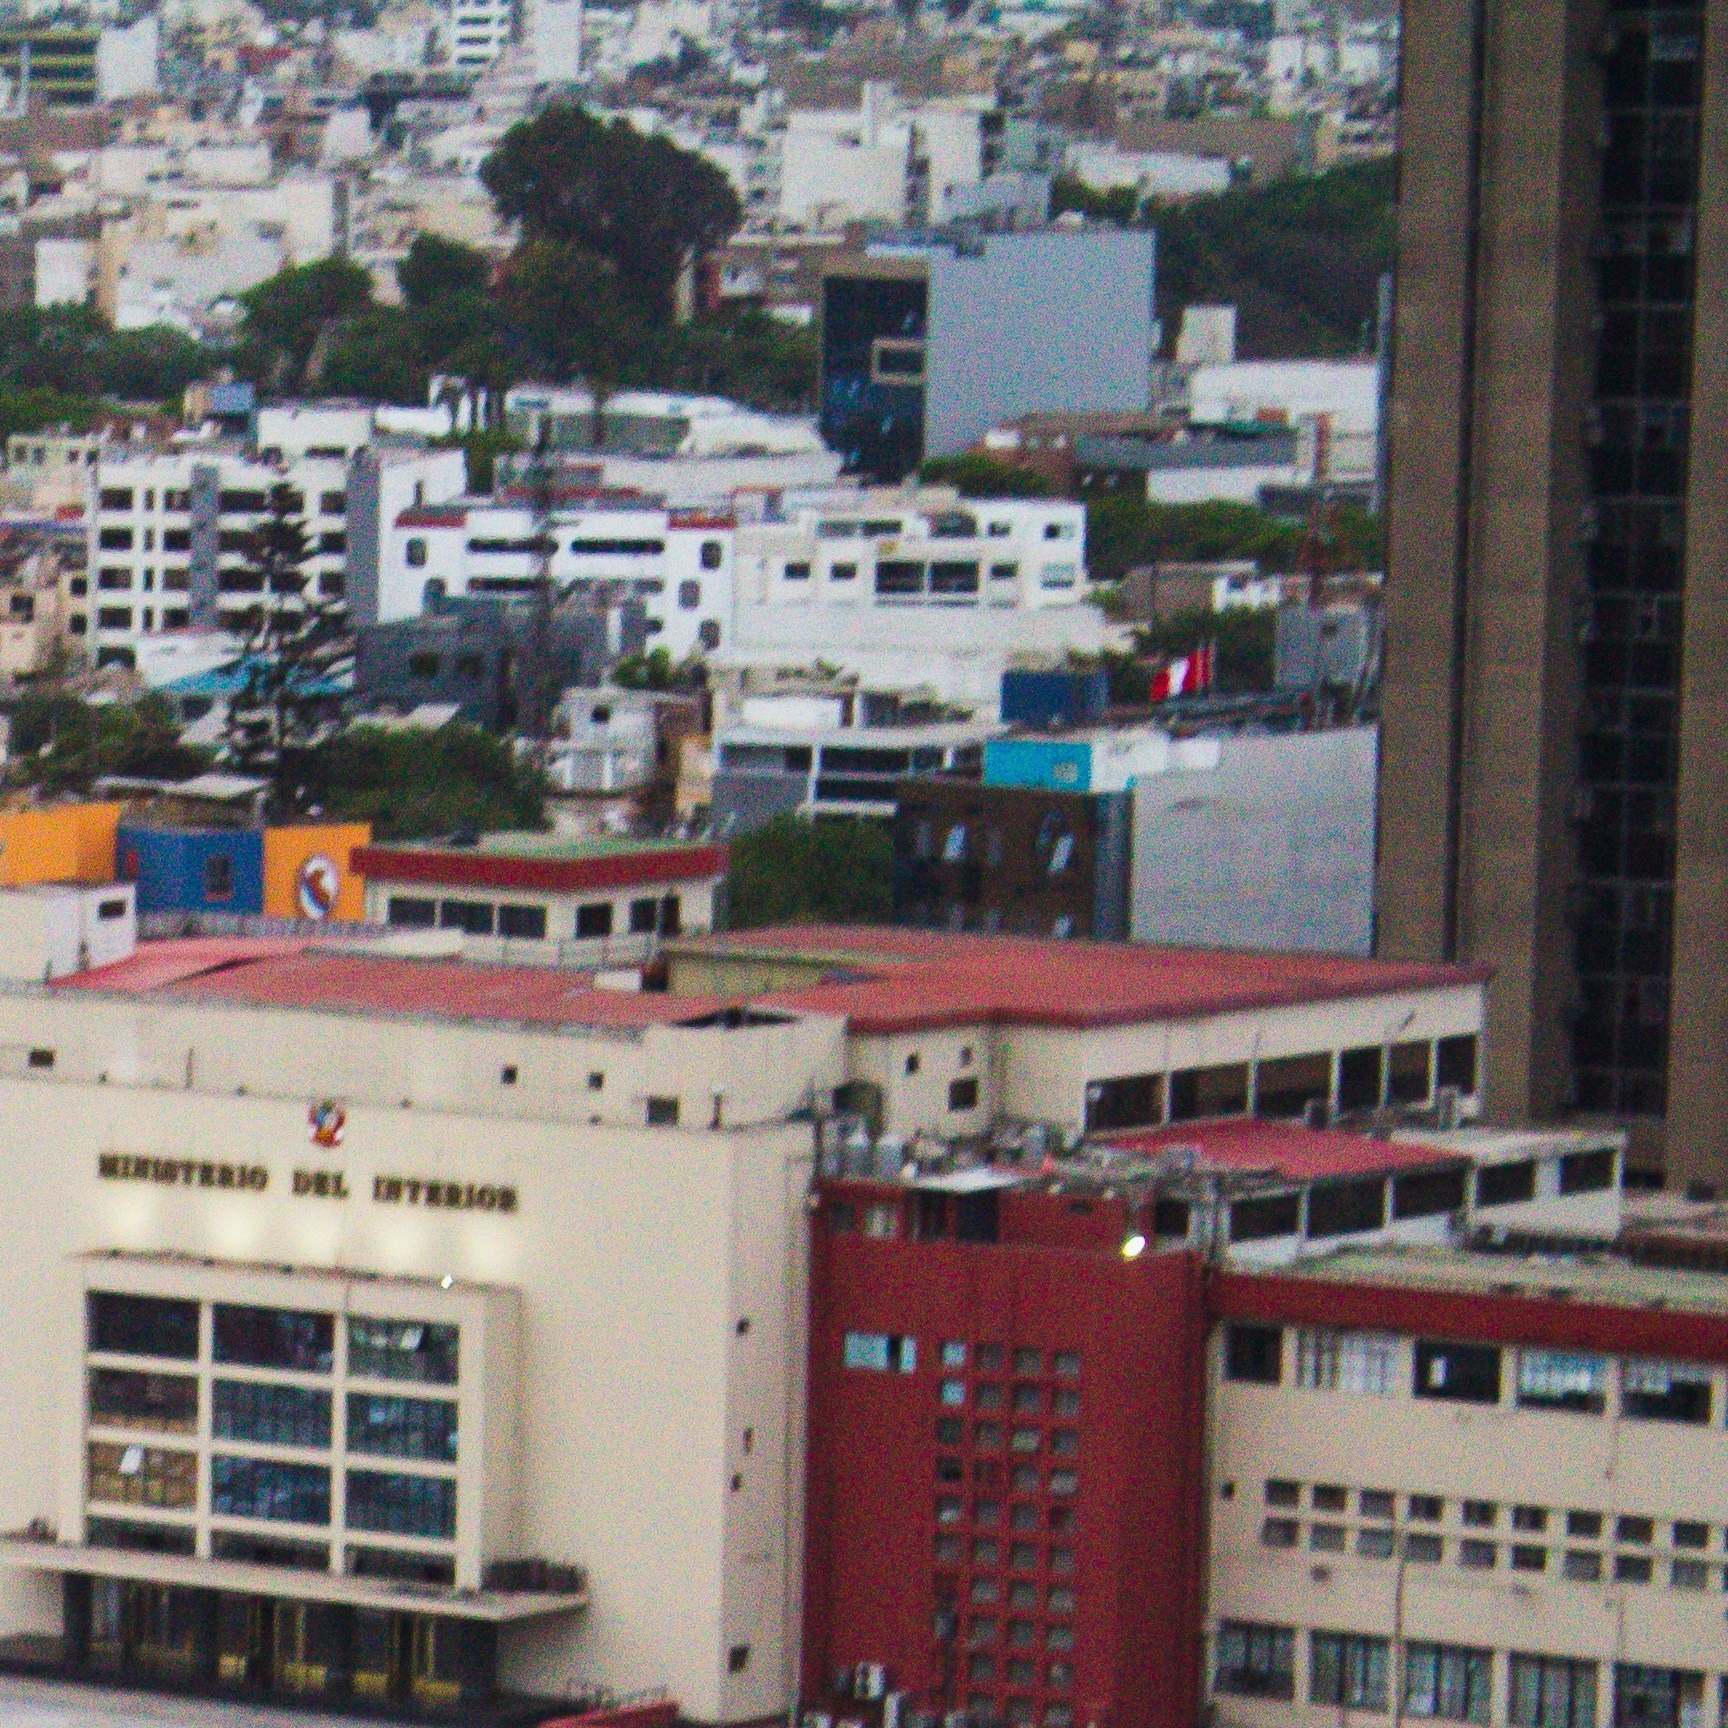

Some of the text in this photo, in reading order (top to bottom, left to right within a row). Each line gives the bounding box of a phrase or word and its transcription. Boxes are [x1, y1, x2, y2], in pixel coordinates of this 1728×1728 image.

[99, 1155, 517, 1213] MINISTERIO DEL INTERIOR
